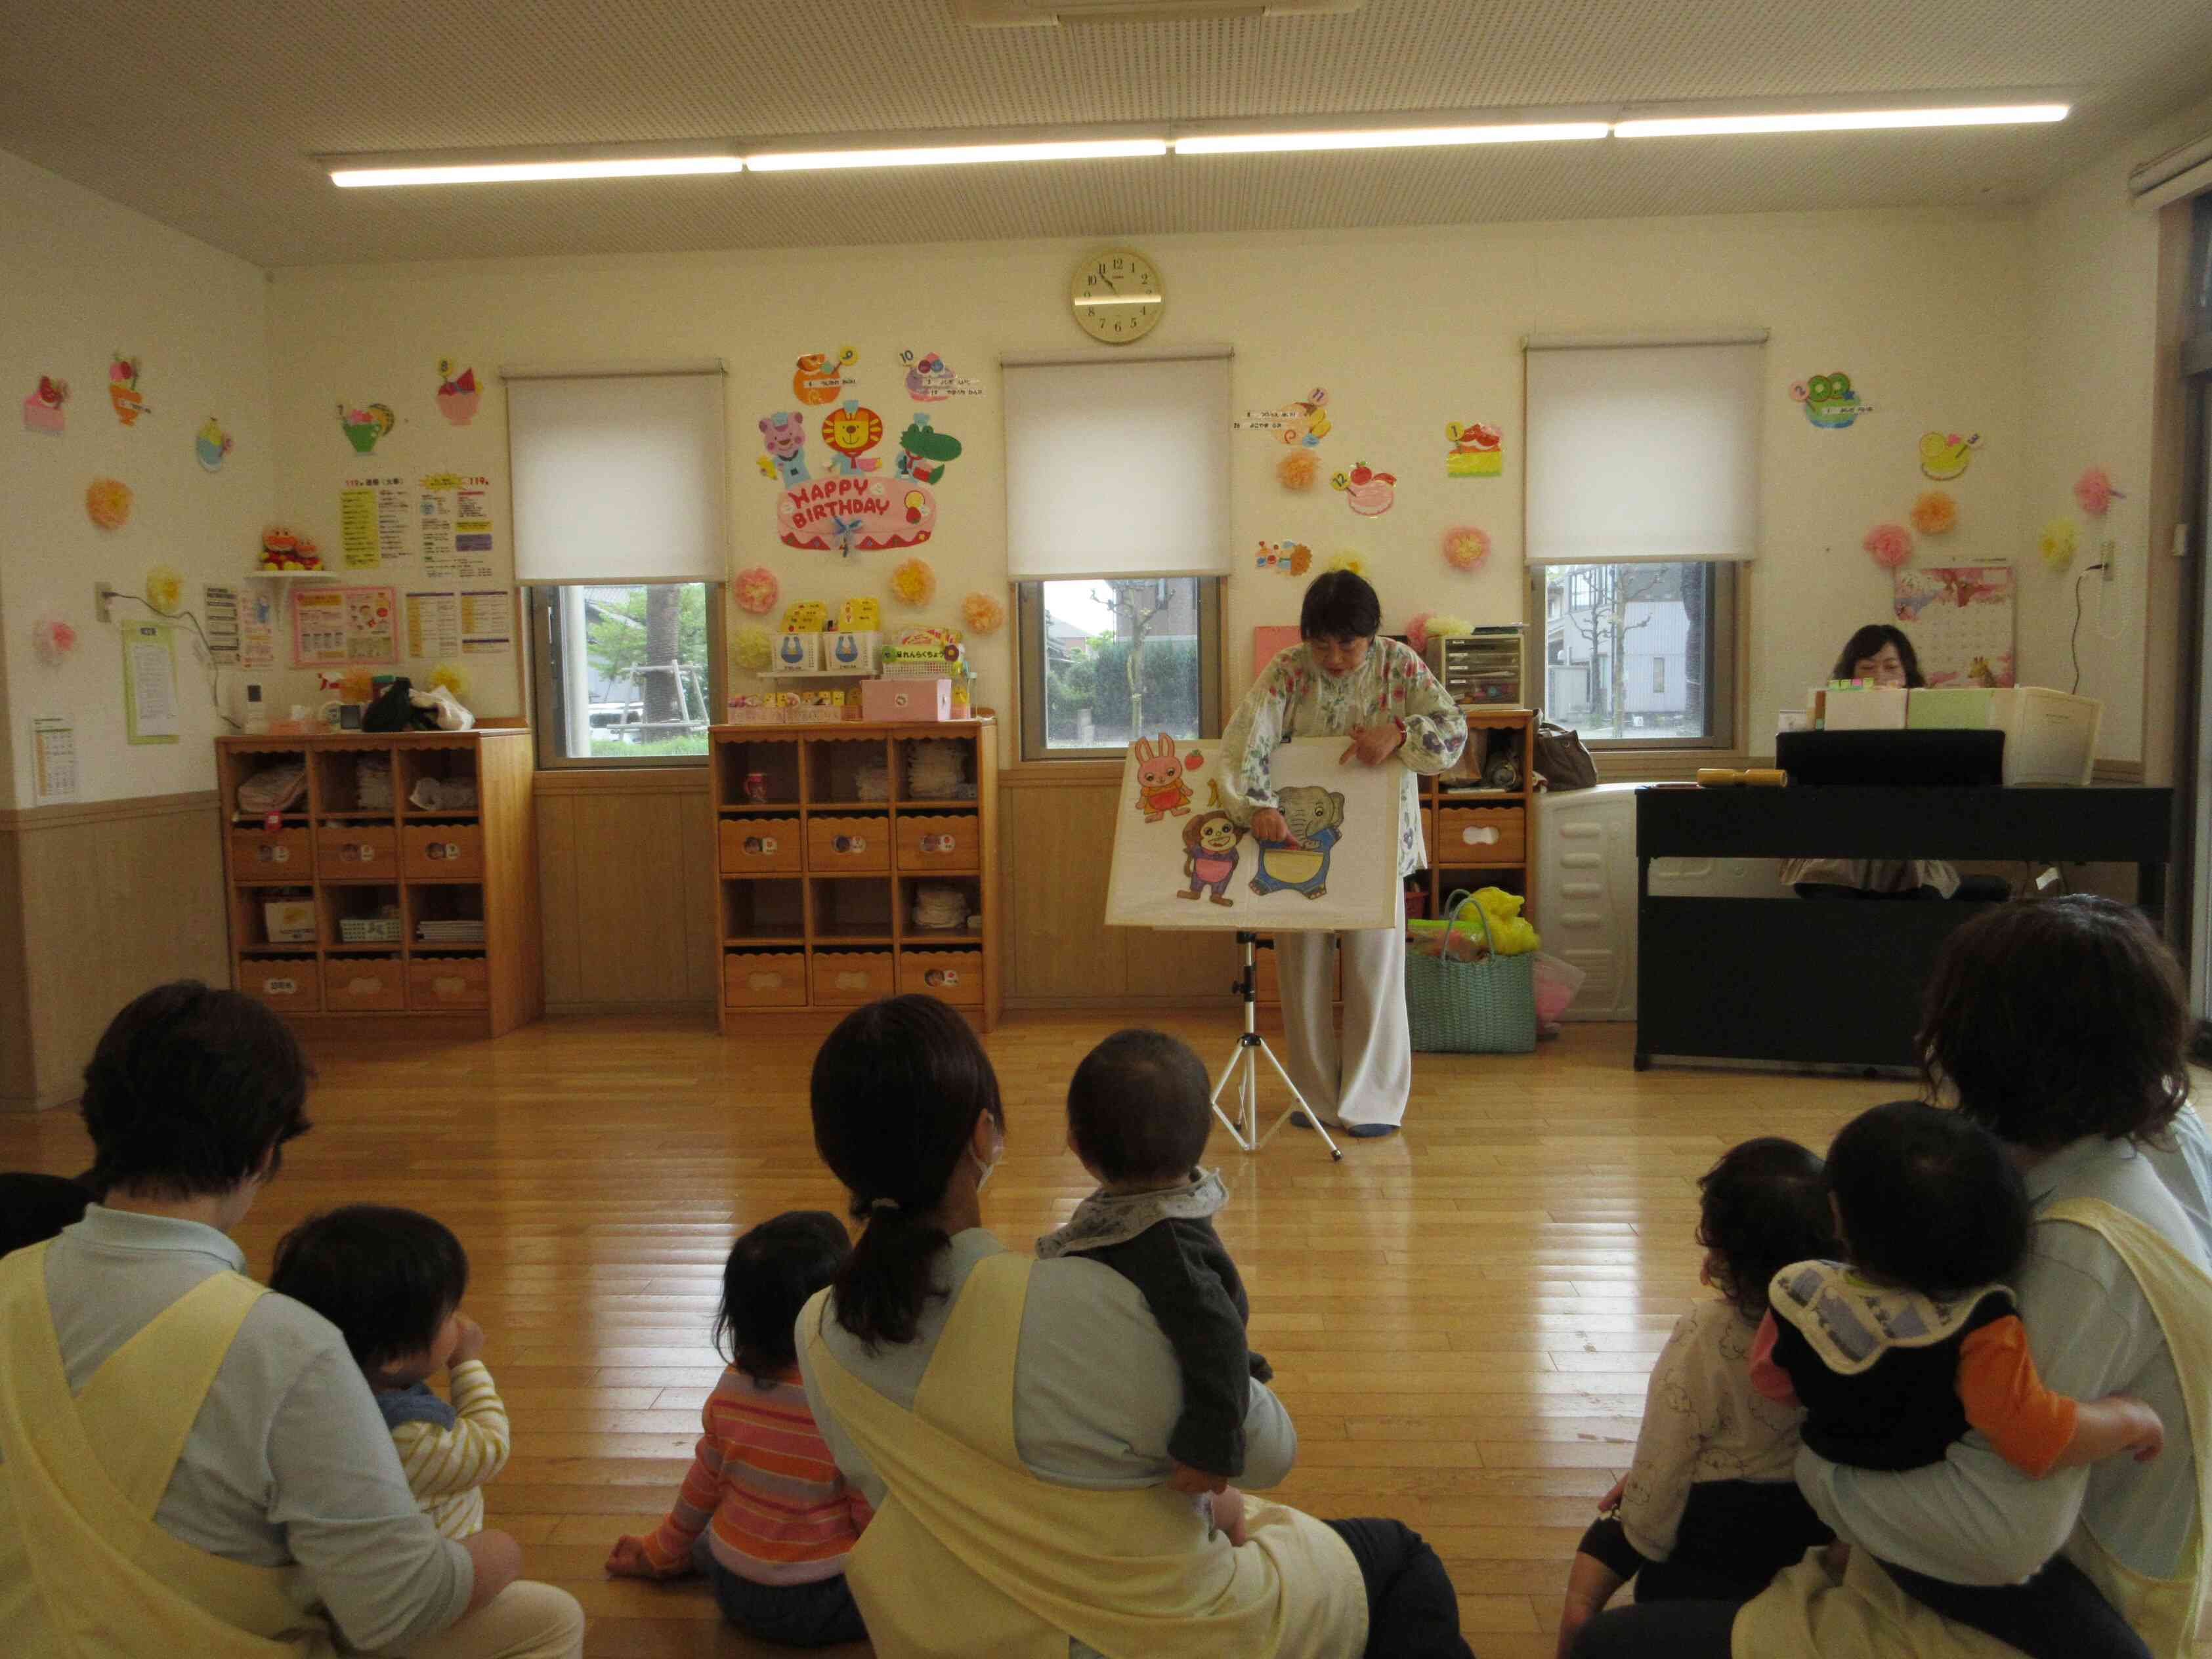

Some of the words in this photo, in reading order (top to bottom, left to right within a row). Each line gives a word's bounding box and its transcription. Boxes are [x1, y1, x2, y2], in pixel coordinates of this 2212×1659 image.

[1099, 264, 1106, 274] 11
[1113, 259, 1123, 270] 12
[1131, 262, 1135, 272] 1
[1088, 276, 1097, 285] 10
[1141, 274, 1147, 284] 2
[1088, 306, 1095, 316] 8
[1099, 318, 1106, 328] 7
[1115, 321, 1122, 331] 6
[1130, 318, 1138, 328] 5
[841, 350, 853, 360] 9
[900, 350, 914, 363] 10
[1312, 388, 1325, 402] 11
[1795, 385, 1806, 396] 2
[1332, 472, 1347, 487] 12
[788, 478, 868, 509] HAPPY
[792, 497, 890, 528] BIRTHDAY
